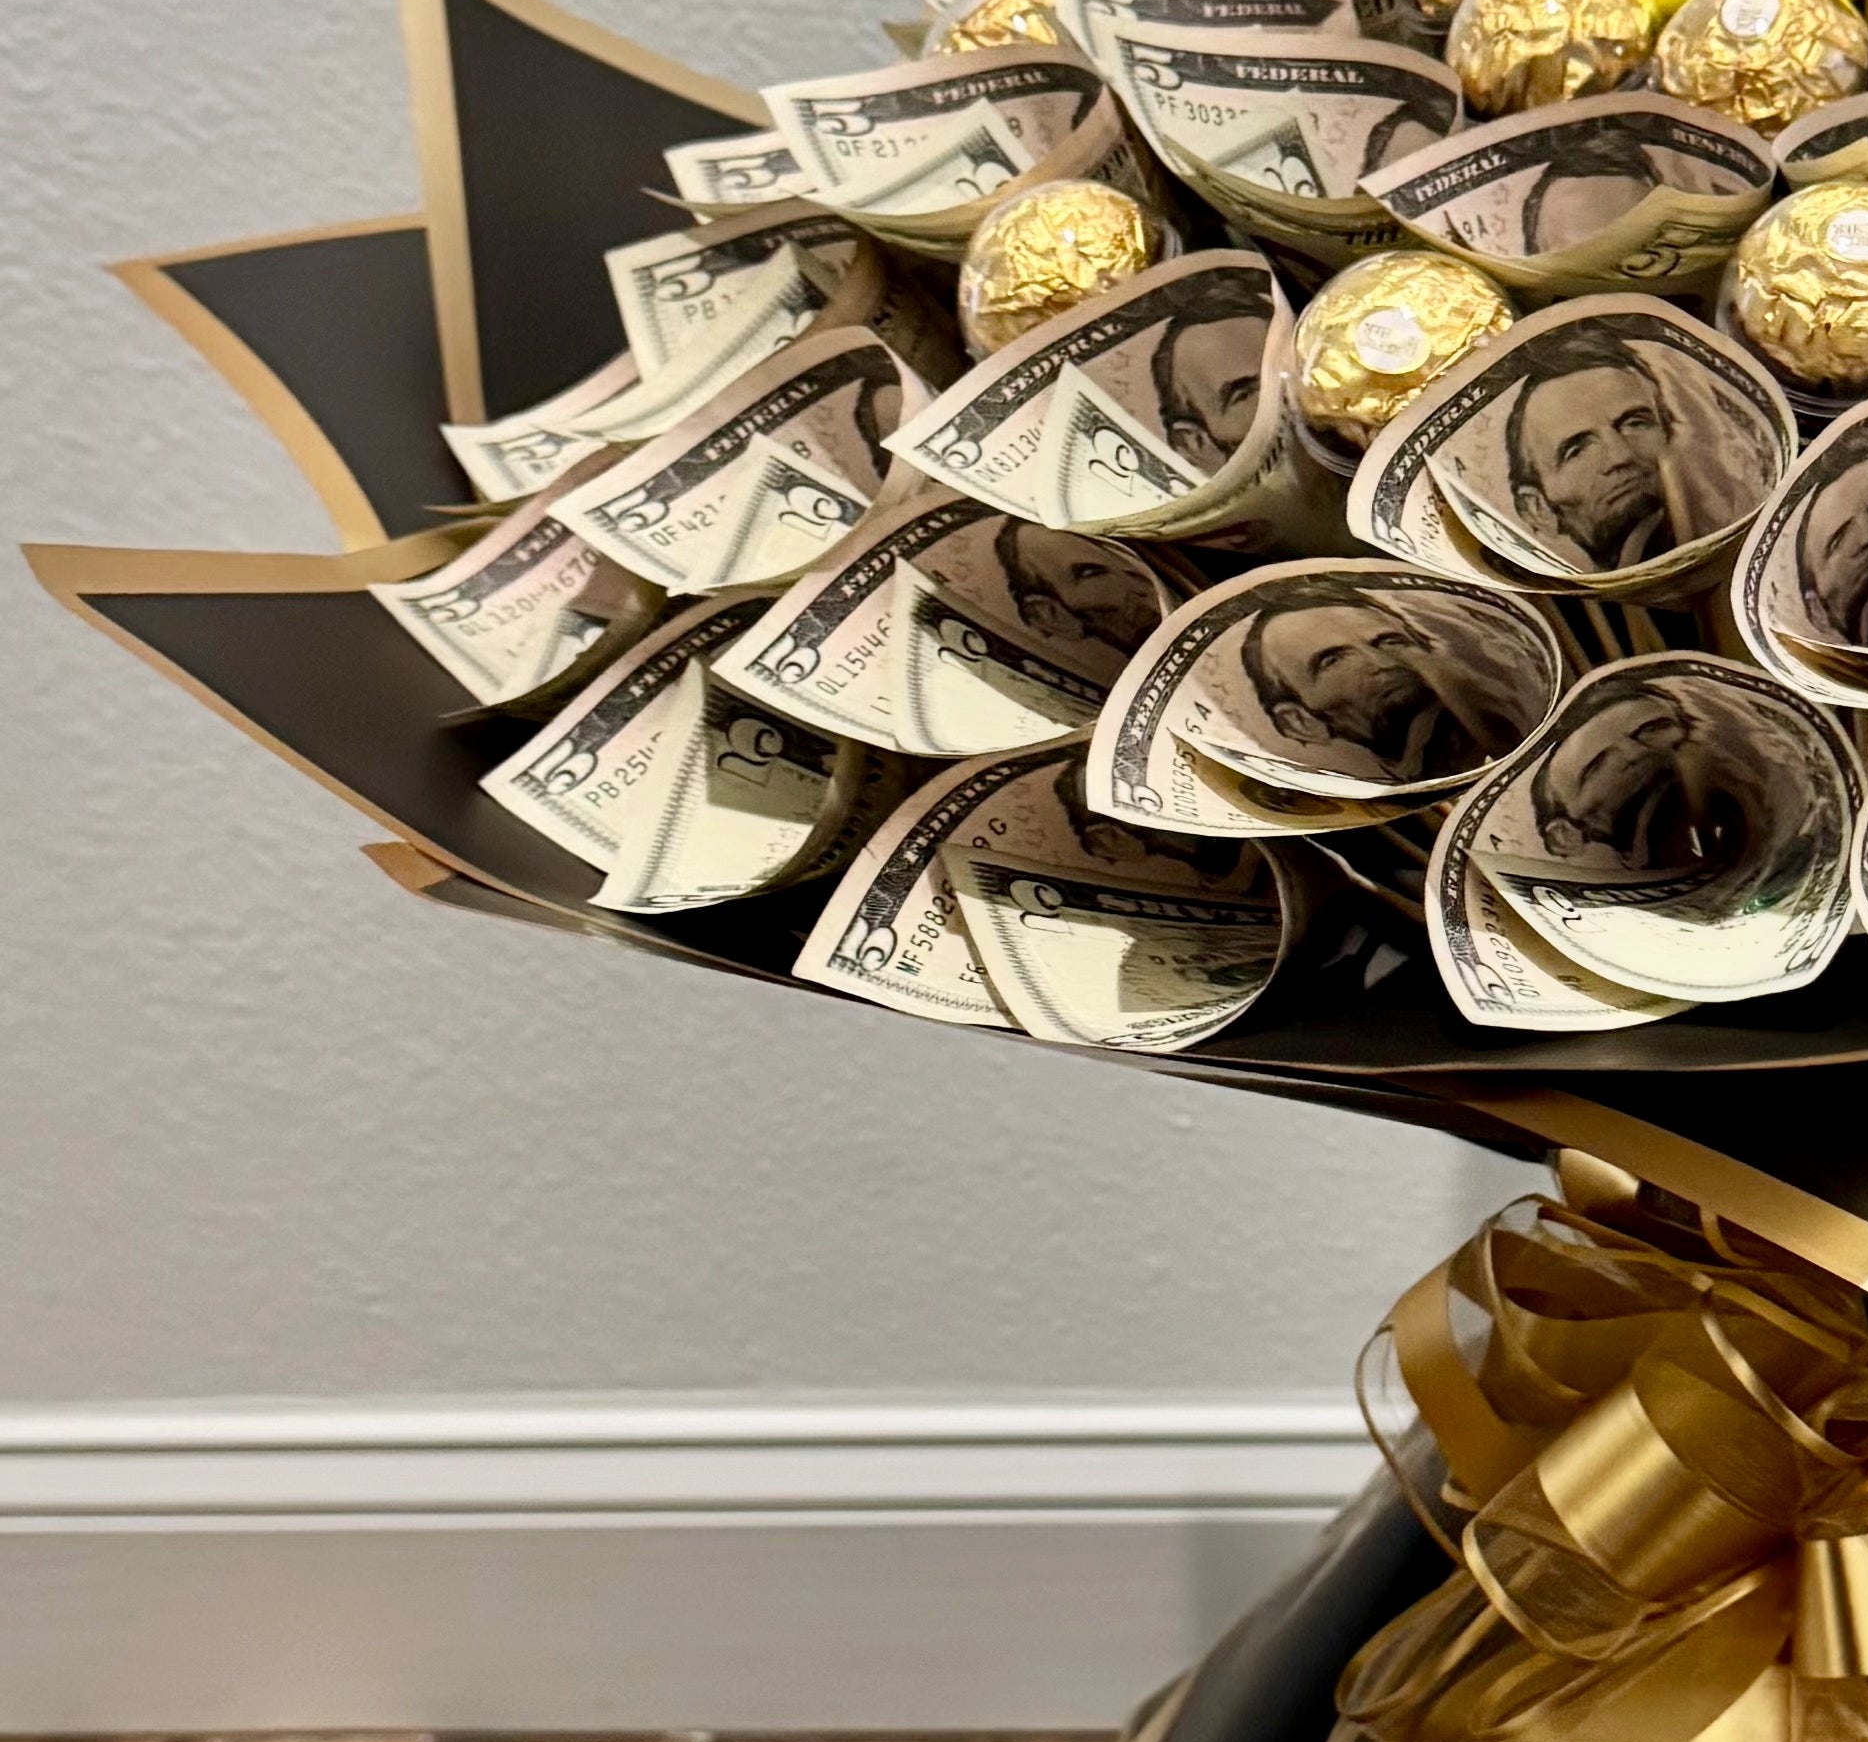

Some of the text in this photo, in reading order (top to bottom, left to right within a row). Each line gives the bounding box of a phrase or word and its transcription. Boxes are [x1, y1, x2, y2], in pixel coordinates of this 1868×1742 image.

[1202, 0, 1306, 19] FEDERAL
[1132, 44, 1366, 91] 5 FEDERAL
[815, 70, 1050, 136] 5 FEDERAL
[1414, 153, 1508, 203] FEDERAL
[652, 262, 714, 304] 5
[998, 320, 1125, 401] FEDERAL
[703, 378, 820, 462] FEDERAL
[936, 424, 983, 470] 5
[609, 488, 670, 534] 5
[842, 510, 960, 596] FEDERAL
[763, 633, 821, 686] 5
[541, 738, 601, 796] 5
[1122, 775, 1166, 816] 5
[842, 916, 900, 973] 5
